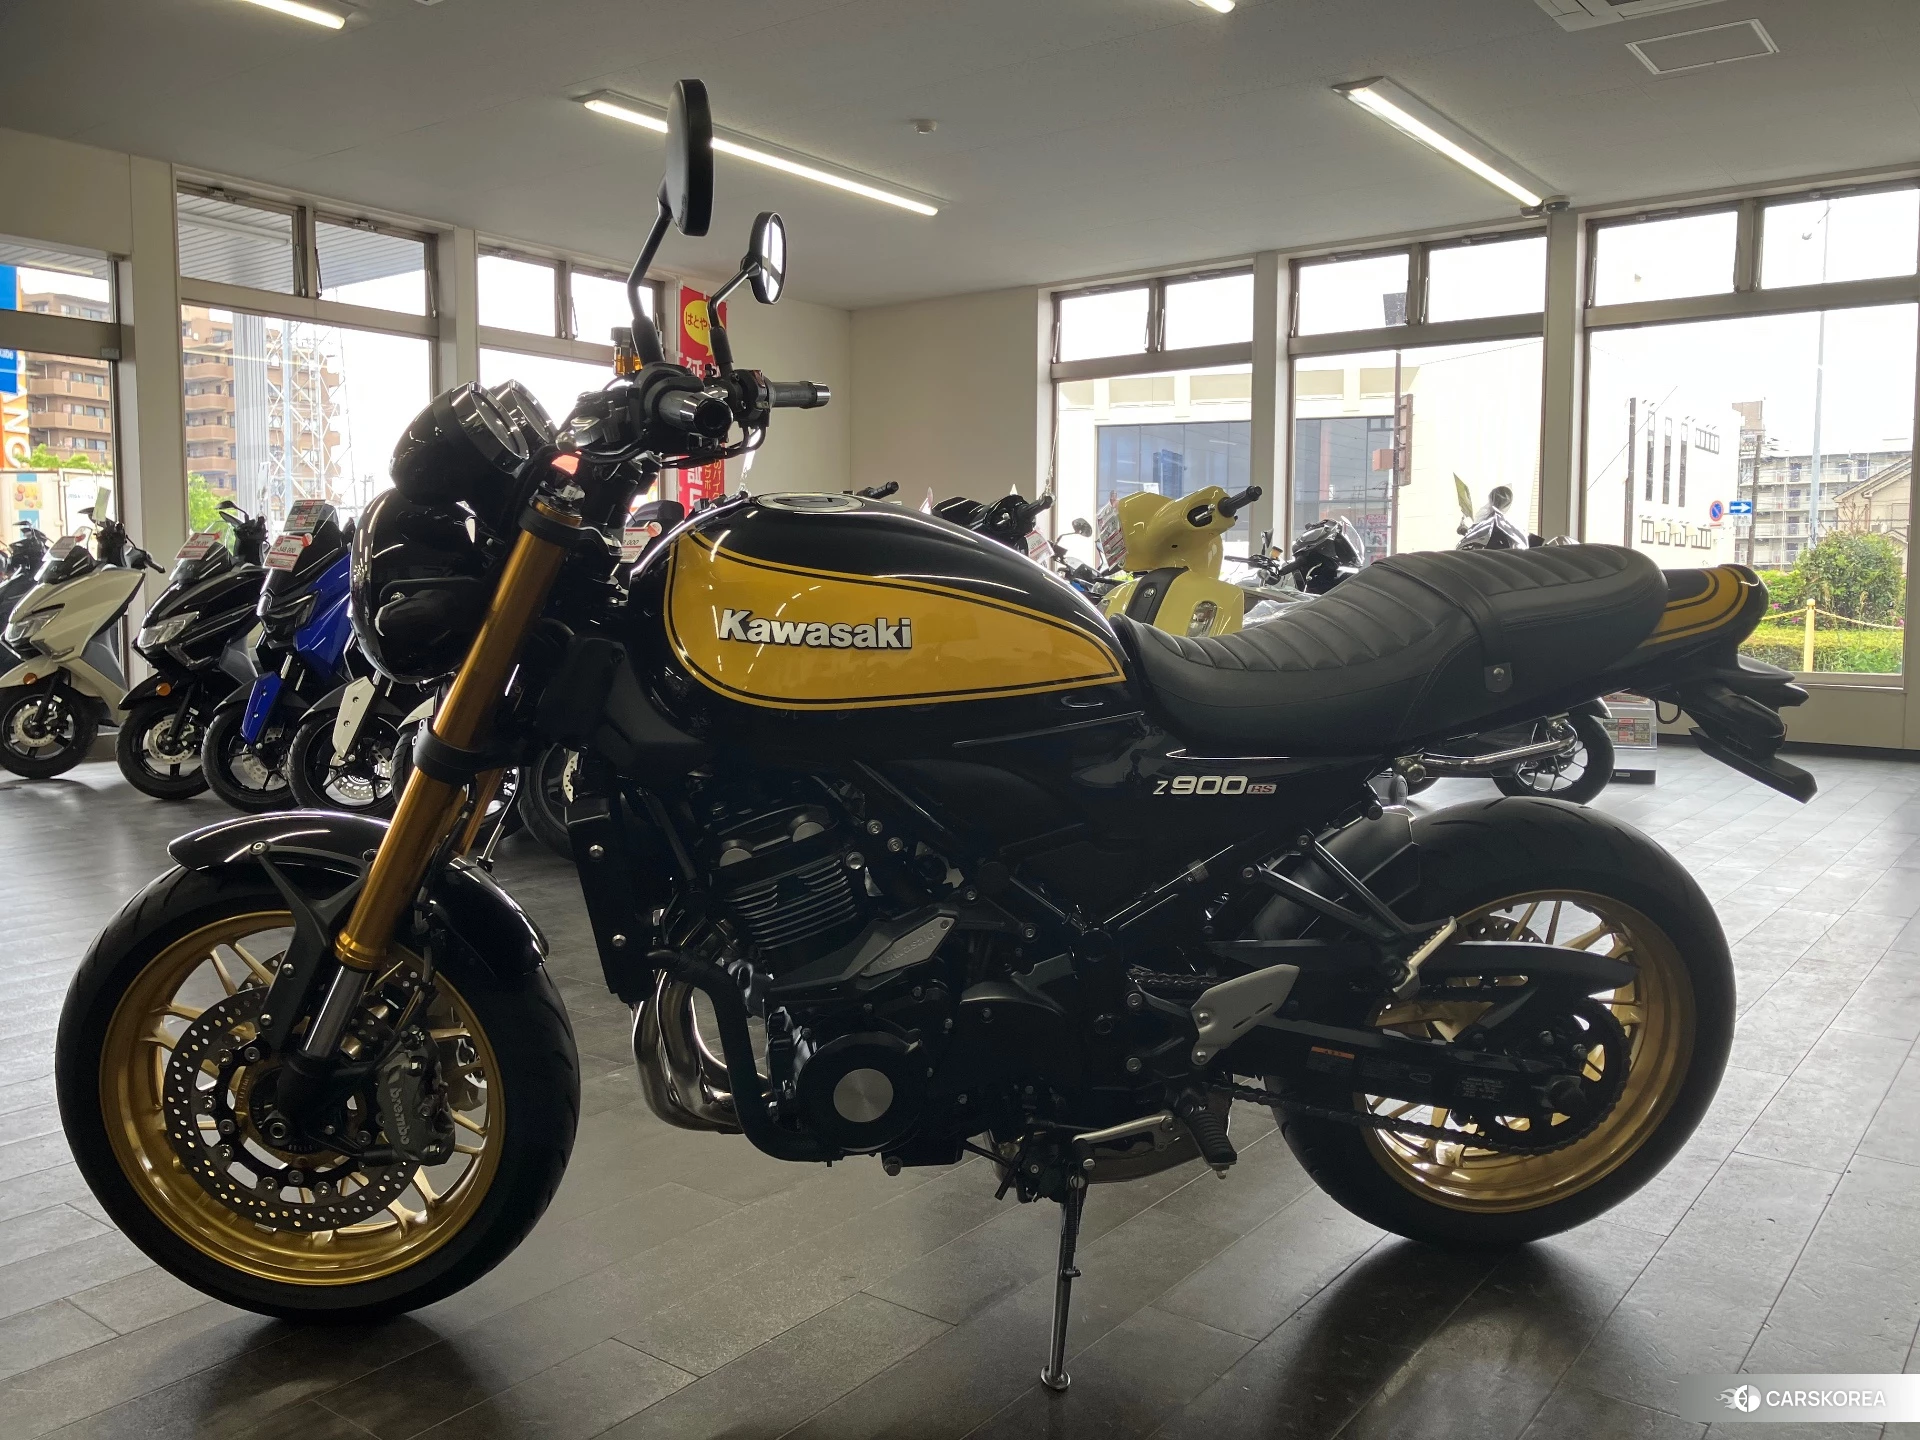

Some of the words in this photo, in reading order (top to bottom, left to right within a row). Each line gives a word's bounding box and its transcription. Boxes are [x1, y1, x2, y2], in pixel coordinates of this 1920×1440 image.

[685, 311, 711, 331] はとや
[718, 608, 913, 649] Kawasaki
[389, 1087, 411, 1145] brembo
